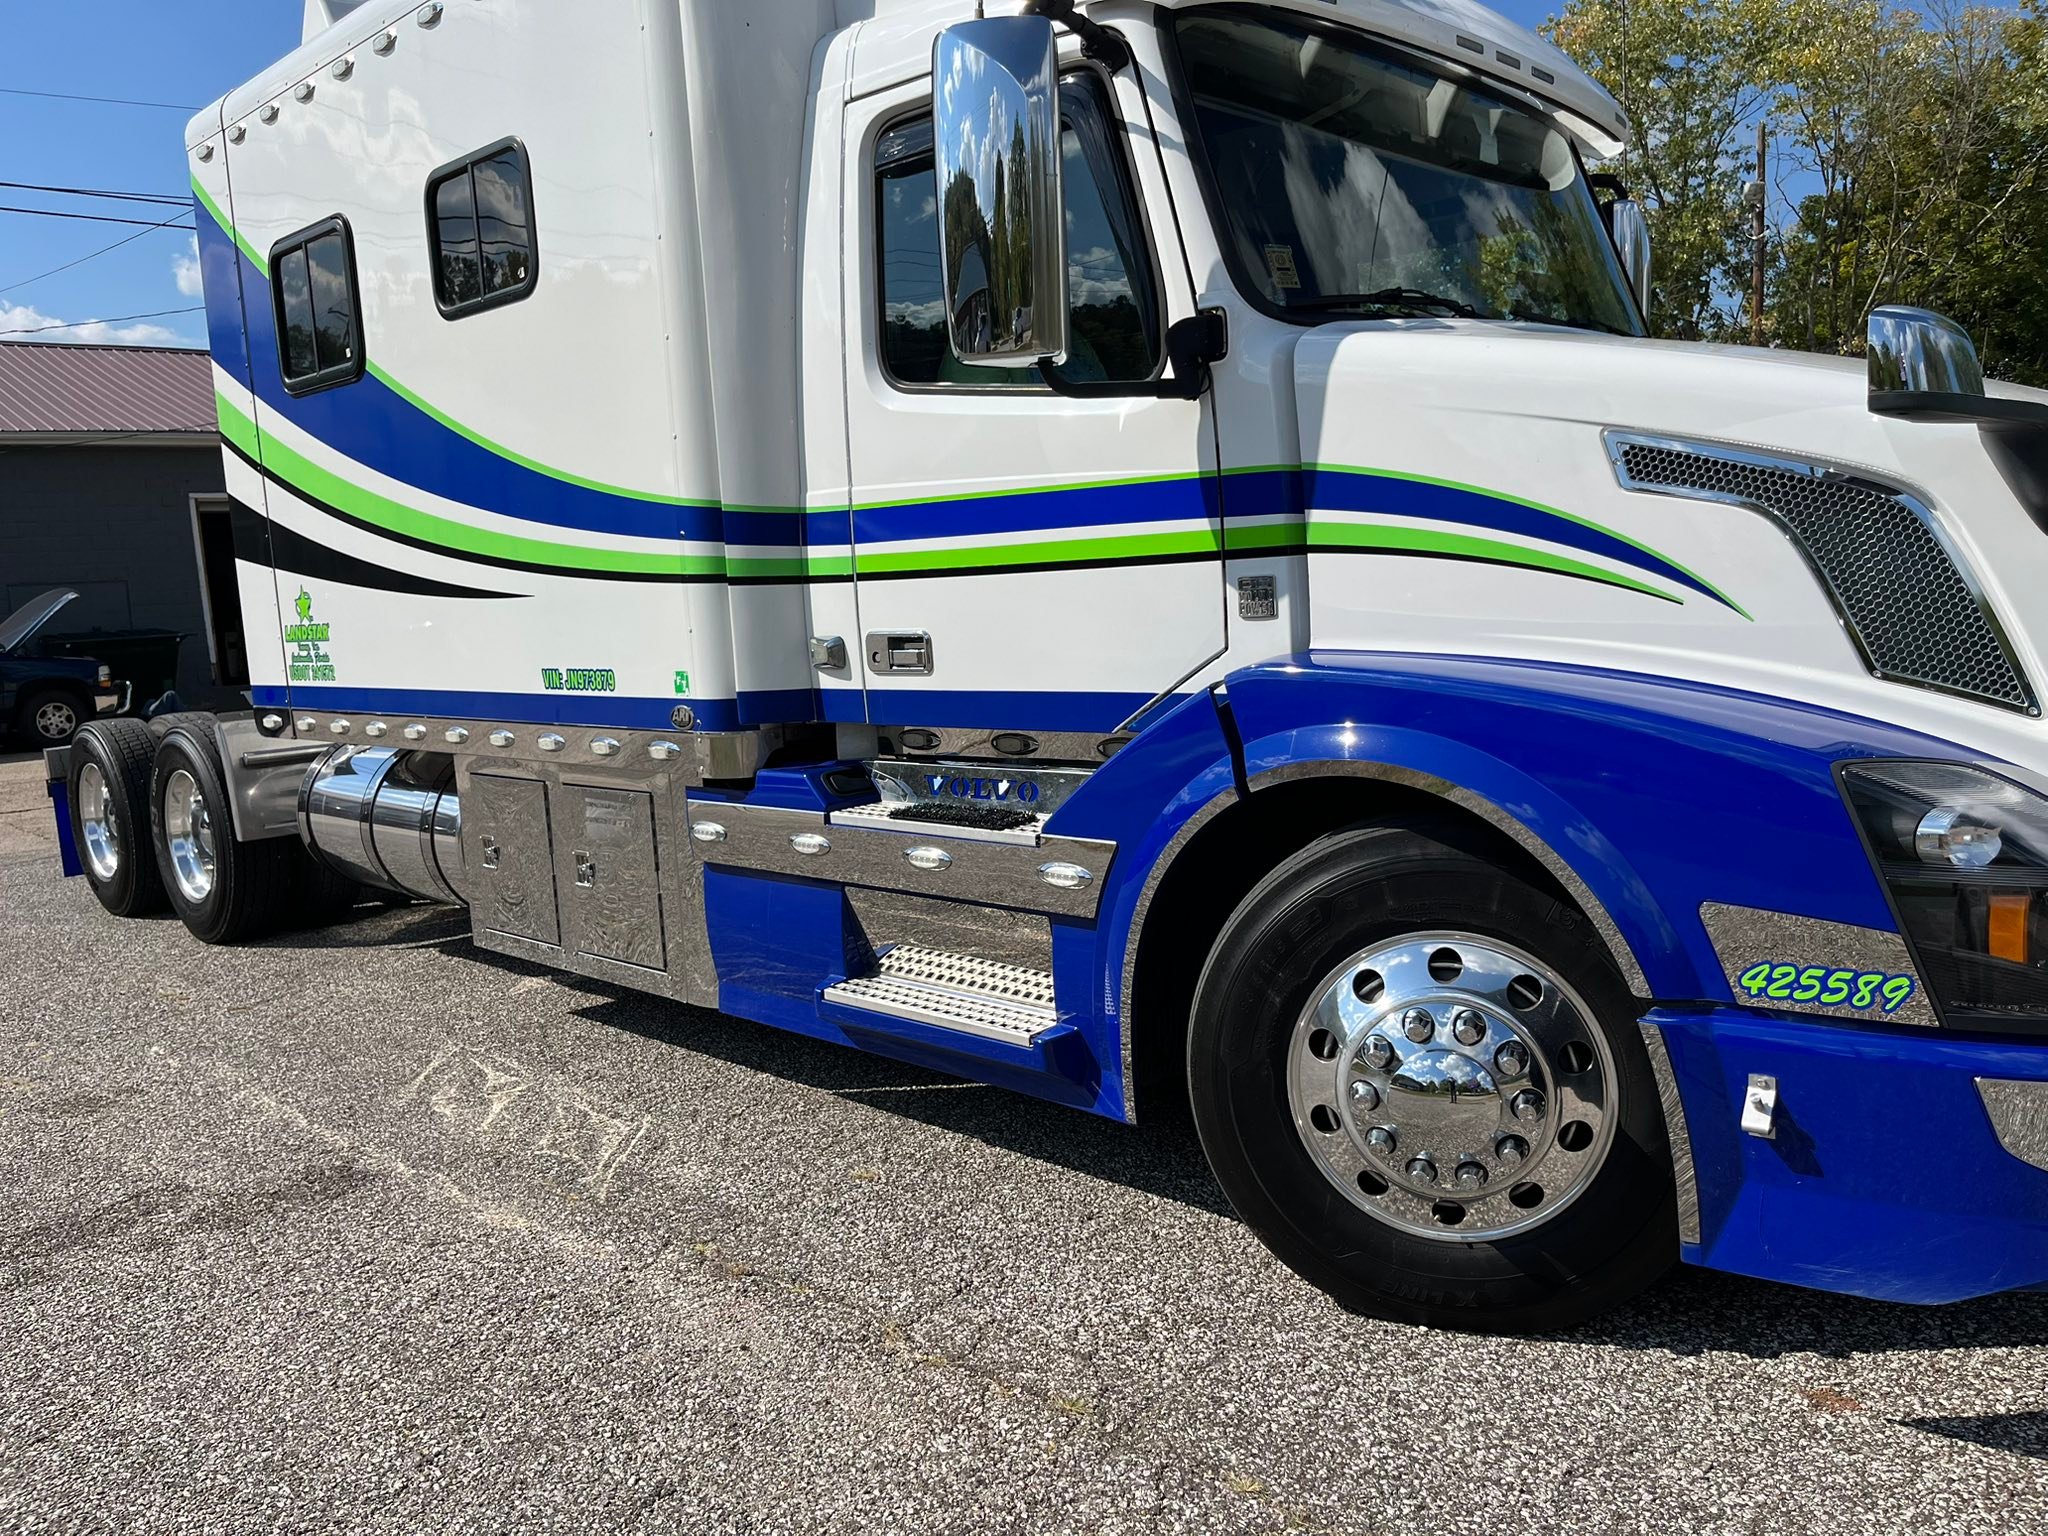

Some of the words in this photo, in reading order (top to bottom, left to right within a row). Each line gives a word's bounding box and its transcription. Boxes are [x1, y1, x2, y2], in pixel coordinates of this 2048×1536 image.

[285, 622, 330, 642] LANDSTAR
[289, 665, 311, 681] USDOT
[542, 668, 564, 690] VIN:
[565, 669, 616, 691] JN973879
[924, 775, 1039, 802] VOLVO
[1739, 961, 1914, 1012] 425589
